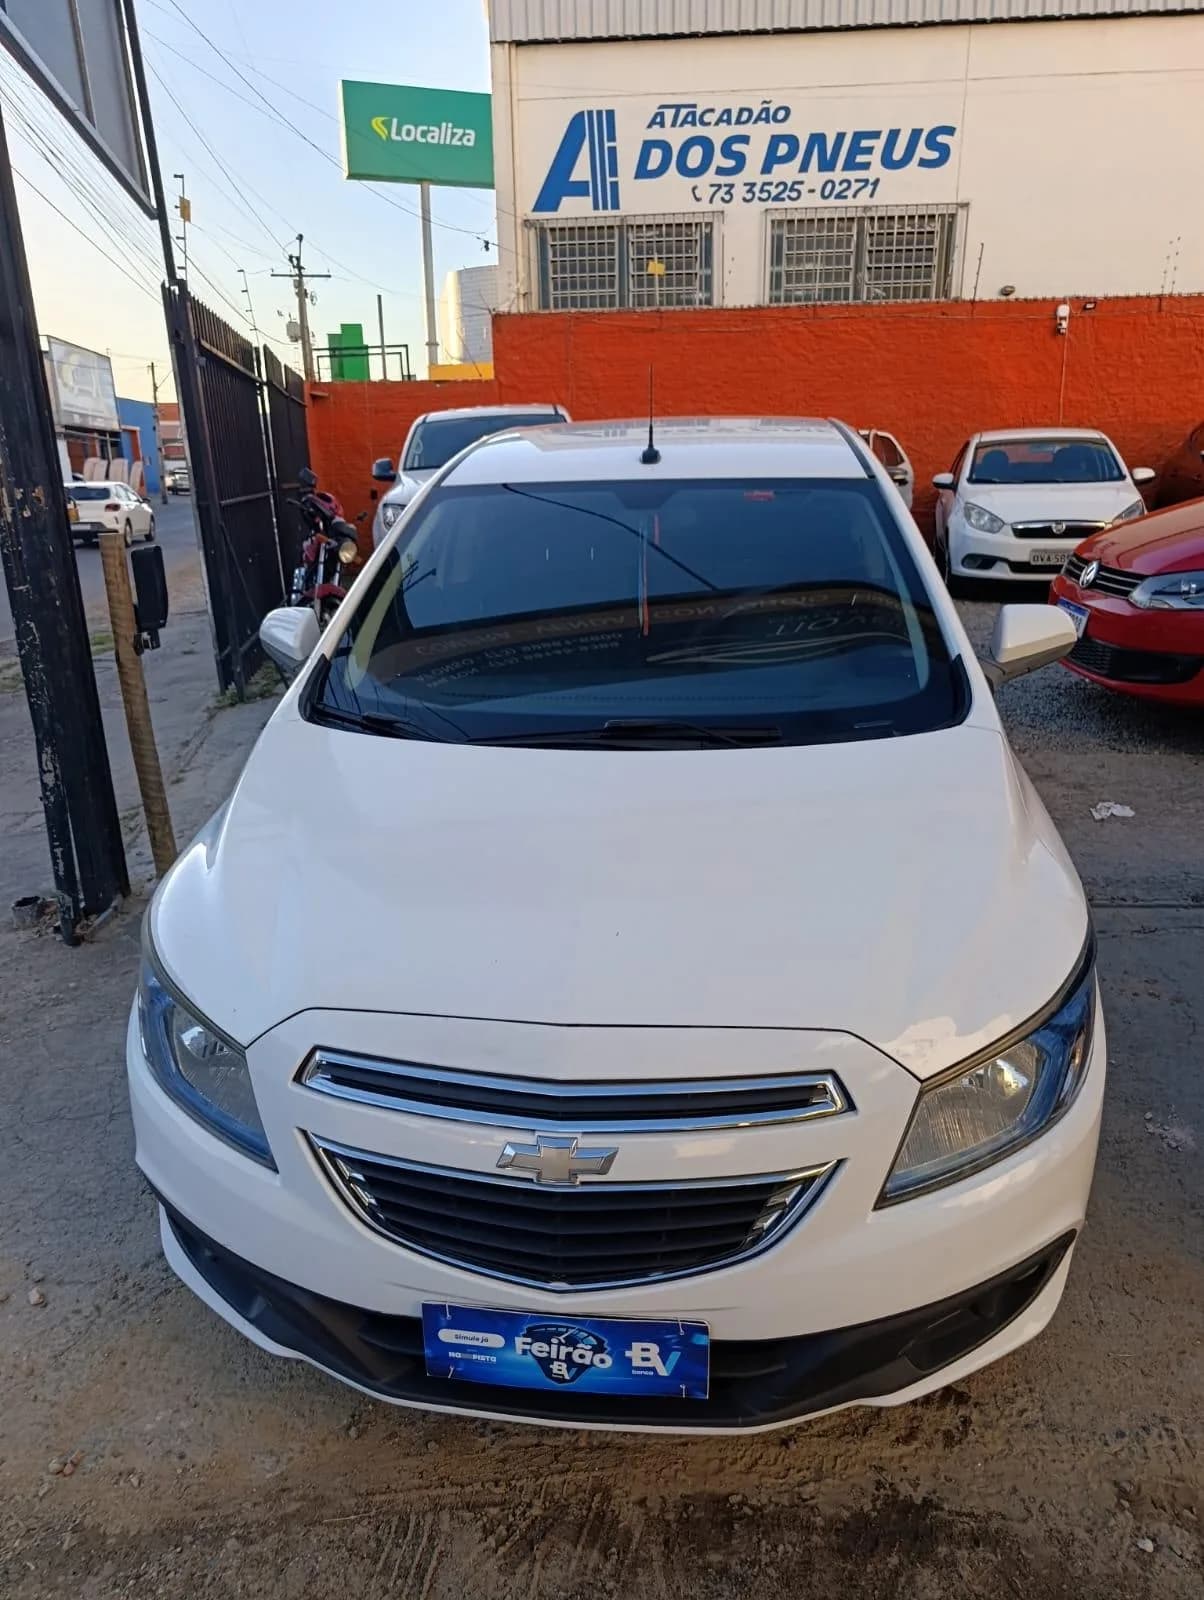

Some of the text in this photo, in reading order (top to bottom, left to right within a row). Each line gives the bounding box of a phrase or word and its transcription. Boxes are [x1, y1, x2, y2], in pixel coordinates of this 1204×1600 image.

[646, 100, 792, 129] ATACADÃO
[391, 117, 476, 148] Localiza
[633, 125, 956, 180] DOS PNEUS
[707, 183, 735, 205] 73
[514, 1336, 613, 1369] Feirão
